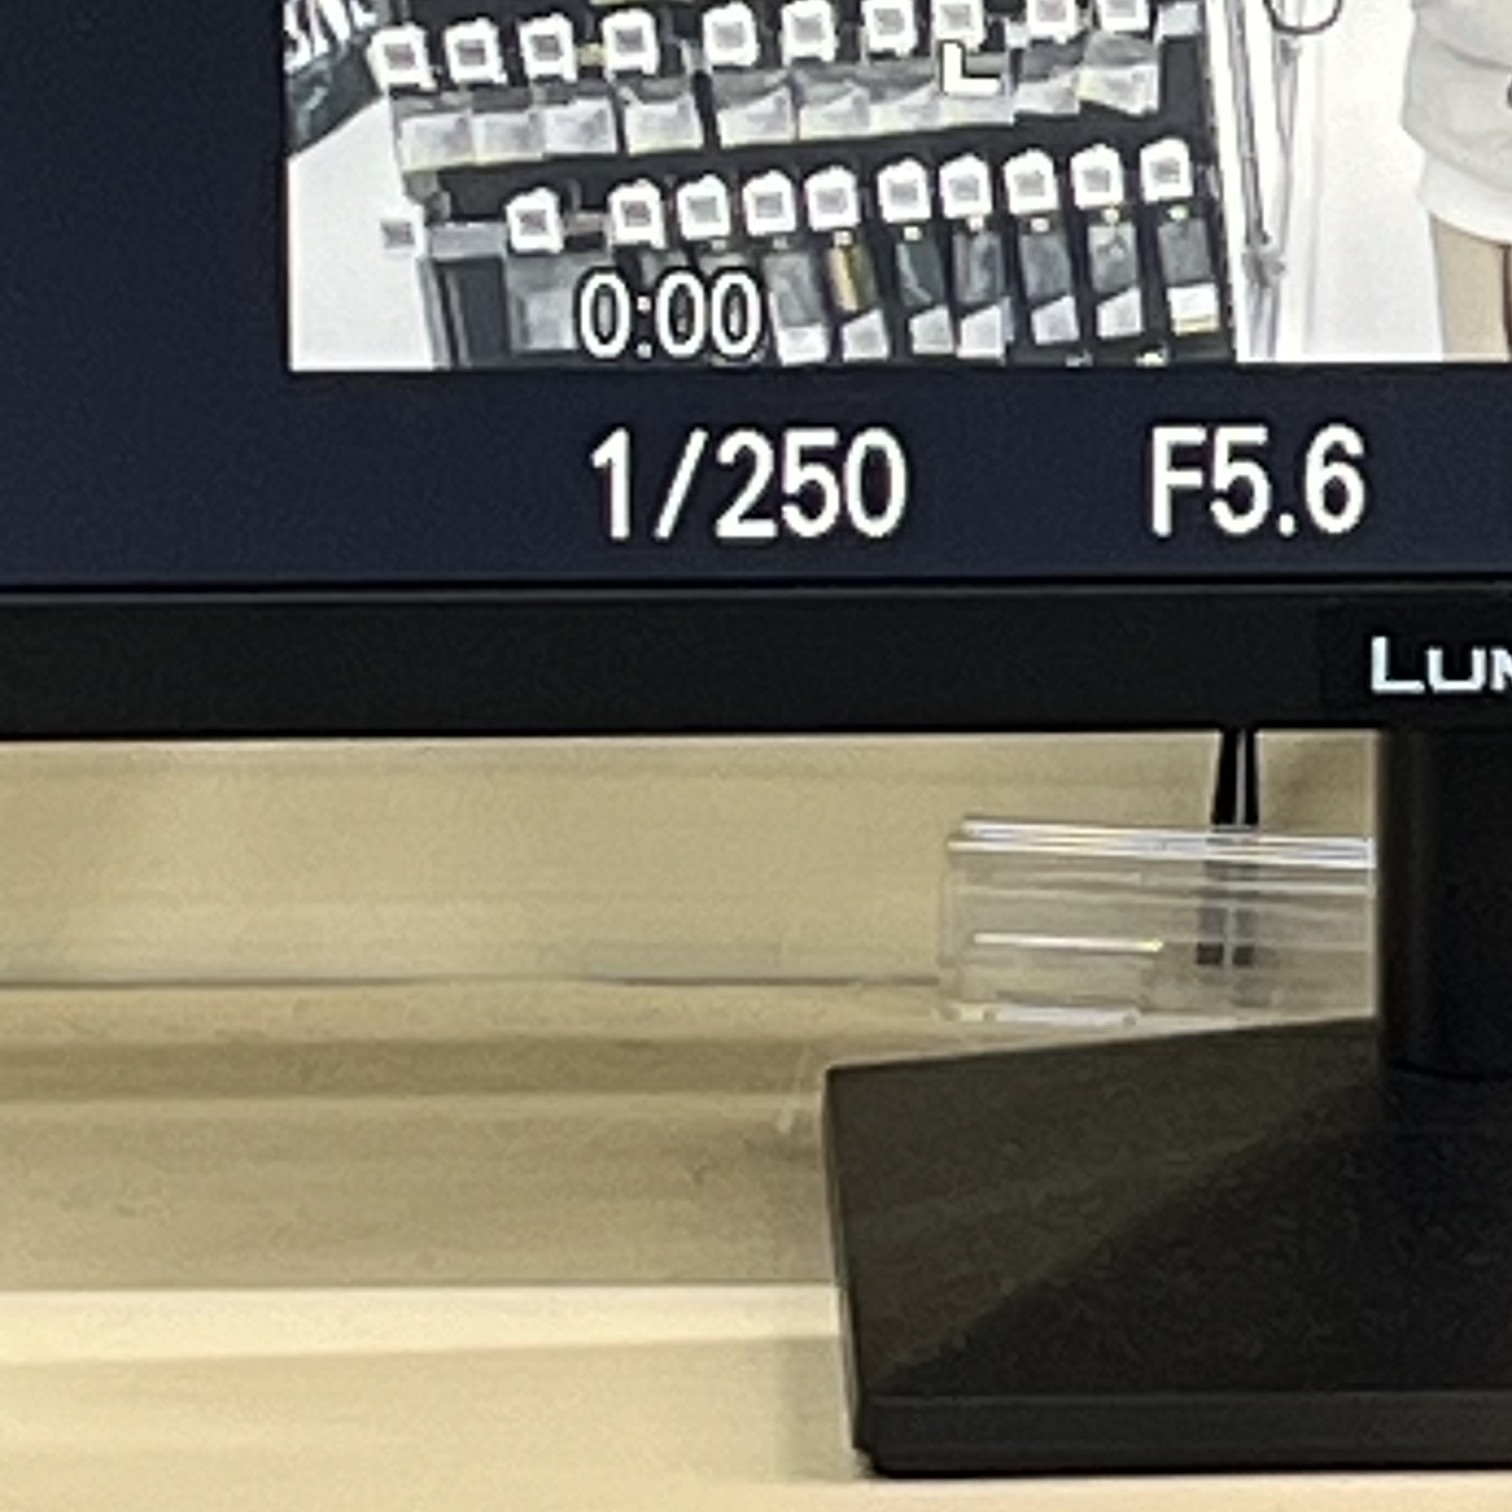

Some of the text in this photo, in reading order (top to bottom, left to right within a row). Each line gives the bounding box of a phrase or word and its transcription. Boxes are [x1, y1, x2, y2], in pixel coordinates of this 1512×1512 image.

[580, 271, 762, 359] 0:00
[590, 427, 908, 539] 1/250
[1150, 423, 1366, 537] F5.6
